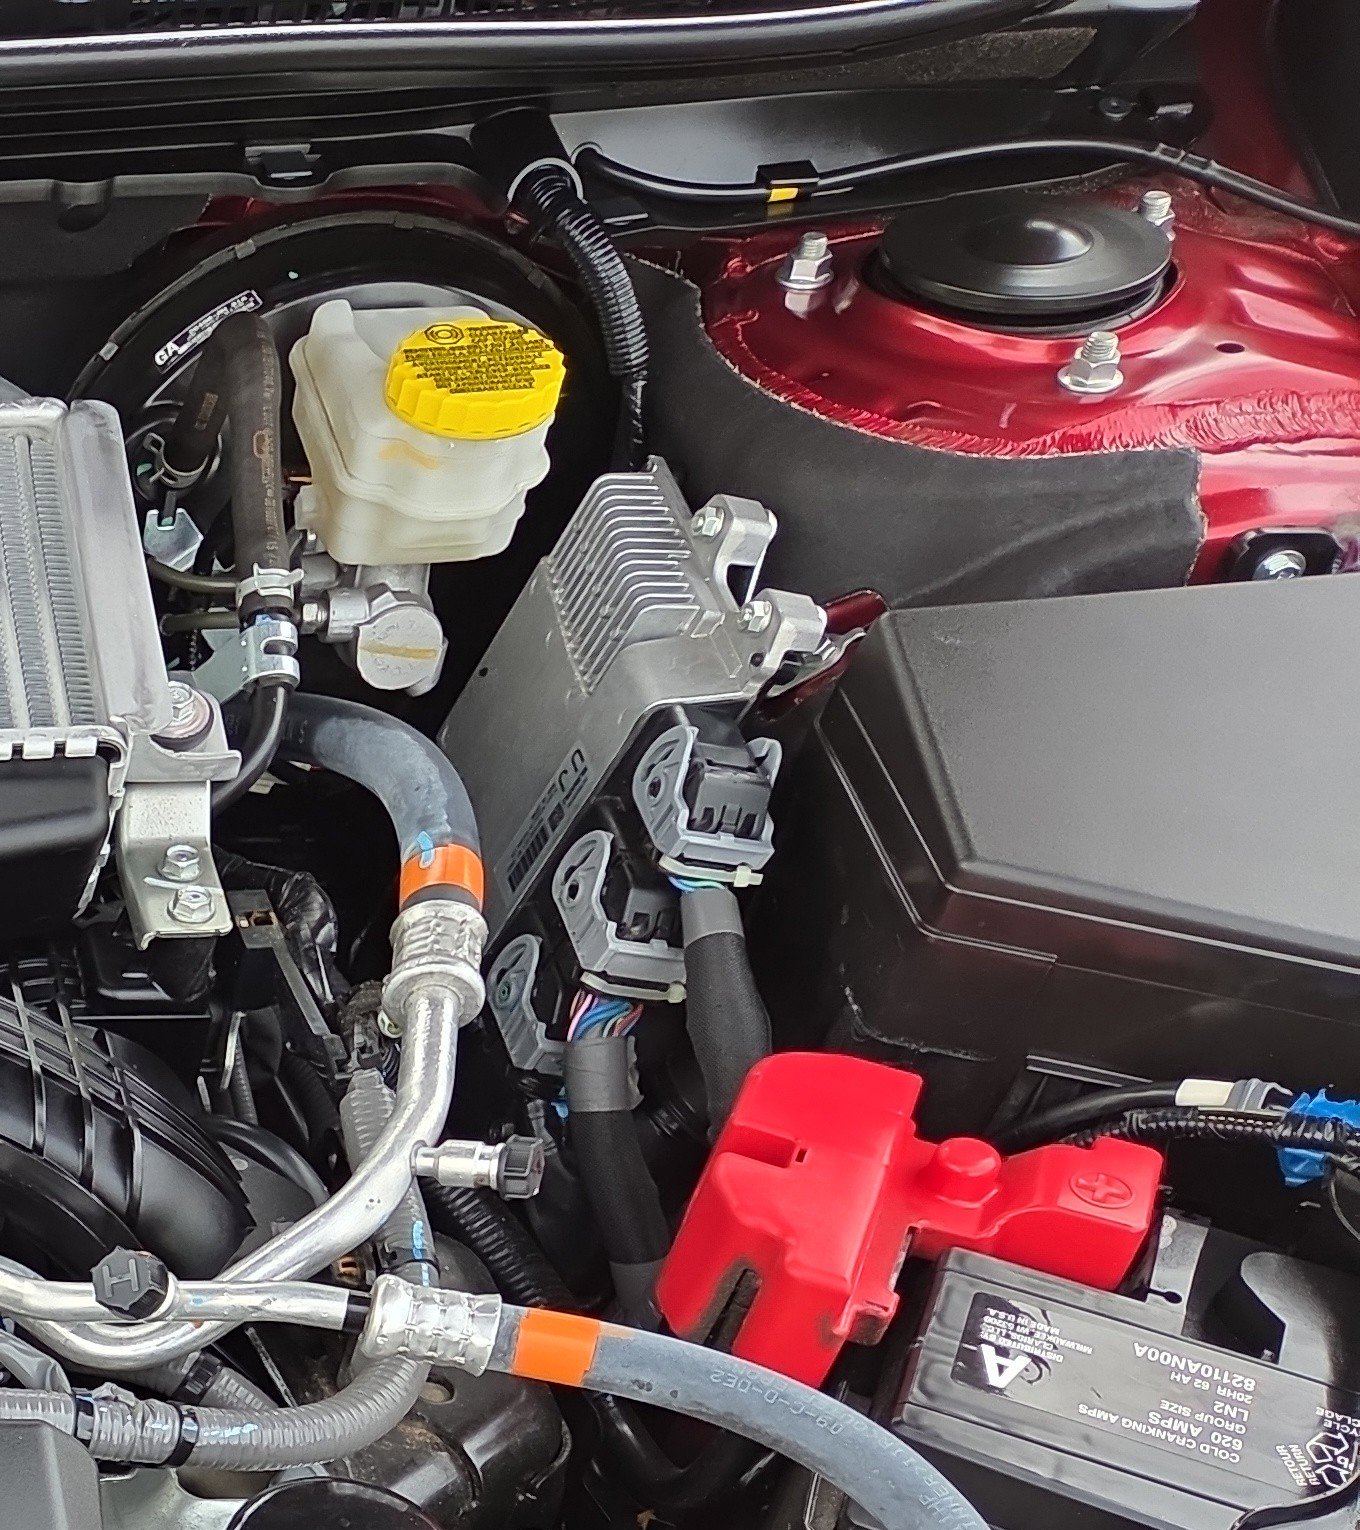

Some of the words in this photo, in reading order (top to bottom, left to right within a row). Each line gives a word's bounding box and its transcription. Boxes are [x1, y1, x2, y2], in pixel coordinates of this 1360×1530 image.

[102, 1258, 139, 1299] H
[1018, 1315, 1028, 1325] IN
[1030, 1321, 1060, 1335] MADE
[999, 1337, 1064, 1363] DISTRIBUTED
[1170, 1371, 1191, 1385] AH
[1194, 1379, 1210, 1390] 62
[1217, 1385, 1253, 1404] 20HR
[1078, 1403, 1119, 1424] AMPS
[1160, 1400, 1191, 1417] SIZE
[1213, 1401, 1249, 1422] LN2
[1121, 1418, 1197, 1449] CRANKING
[1148, 1411, 1203, 1438] AMPS
[1195, 1412, 1246, 1435] GROUP
[1211, 1431, 1243, 1451] 620
[1199, 1443, 1240, 1463] COLD
[1276, 1445, 1308, 1487] RETOUR
[1288, 1444, 1321, 1486] RETURN
